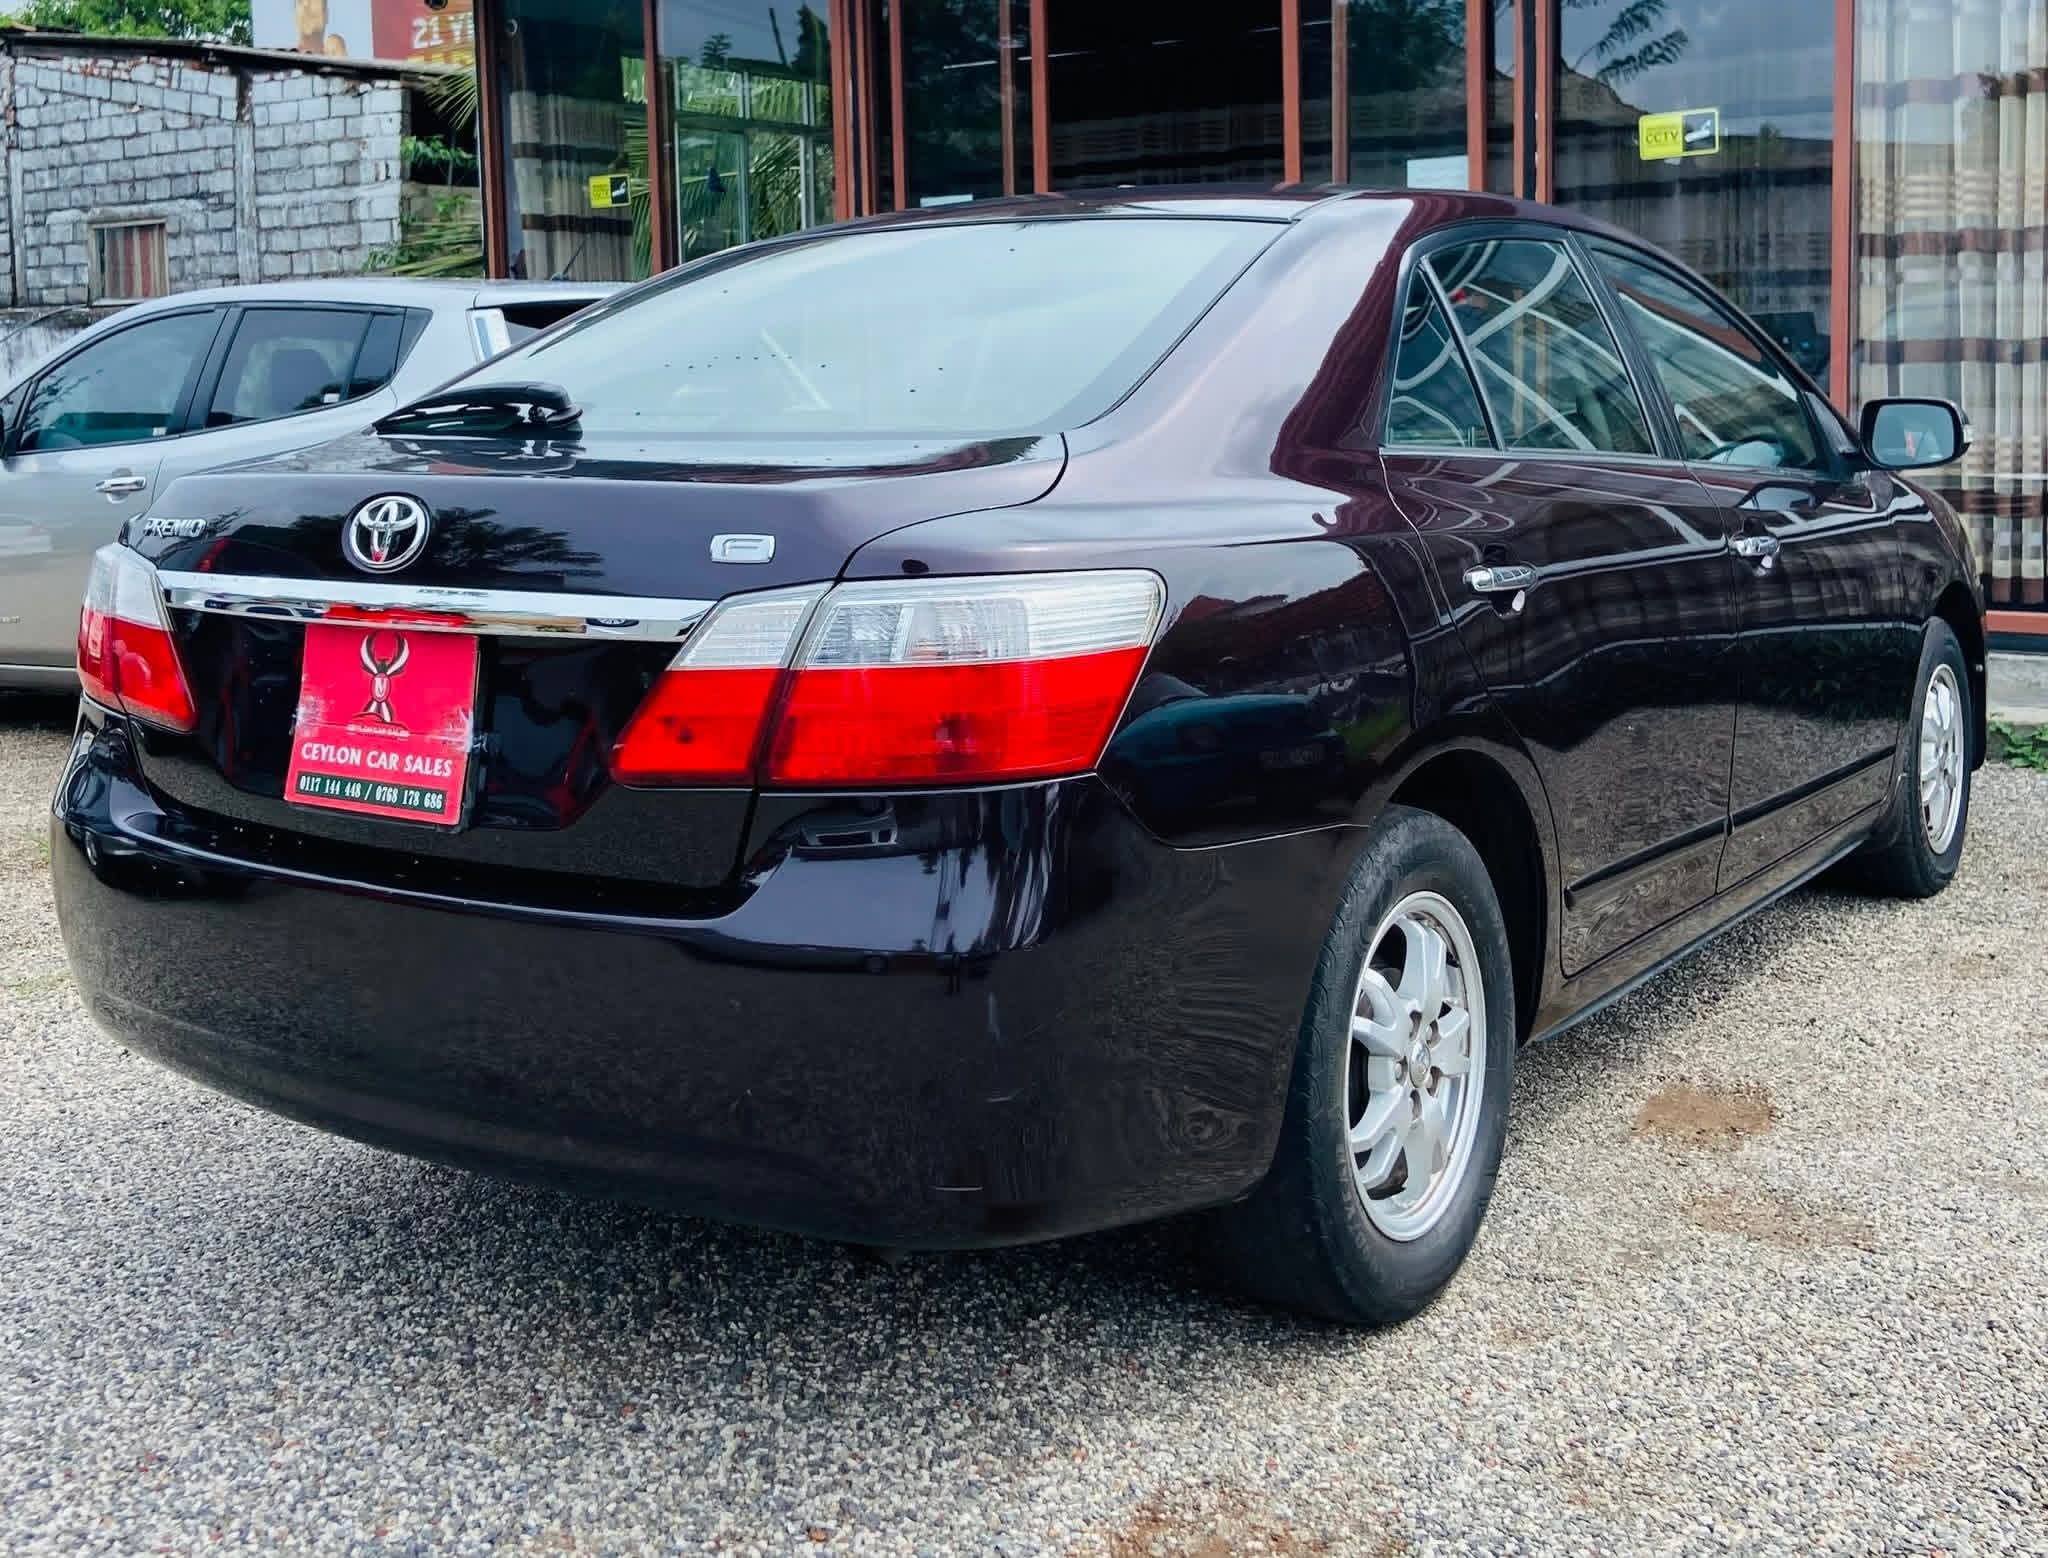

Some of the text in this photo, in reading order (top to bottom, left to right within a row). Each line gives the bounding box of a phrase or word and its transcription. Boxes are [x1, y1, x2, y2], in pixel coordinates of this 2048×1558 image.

[412, 16, 442, 48] 21
[143, 517, 207, 538] PREMIO
[301, 742, 453, 778] CEYLON CAR SALES
[299, 775, 321, 792] 0117
[325, 779, 341, 795] 144
[344, 782, 362, 798] 448
[375, 785, 398, 803] 0768
[402, 789, 419, 807] 178
[424, 792, 443, 810] 686
